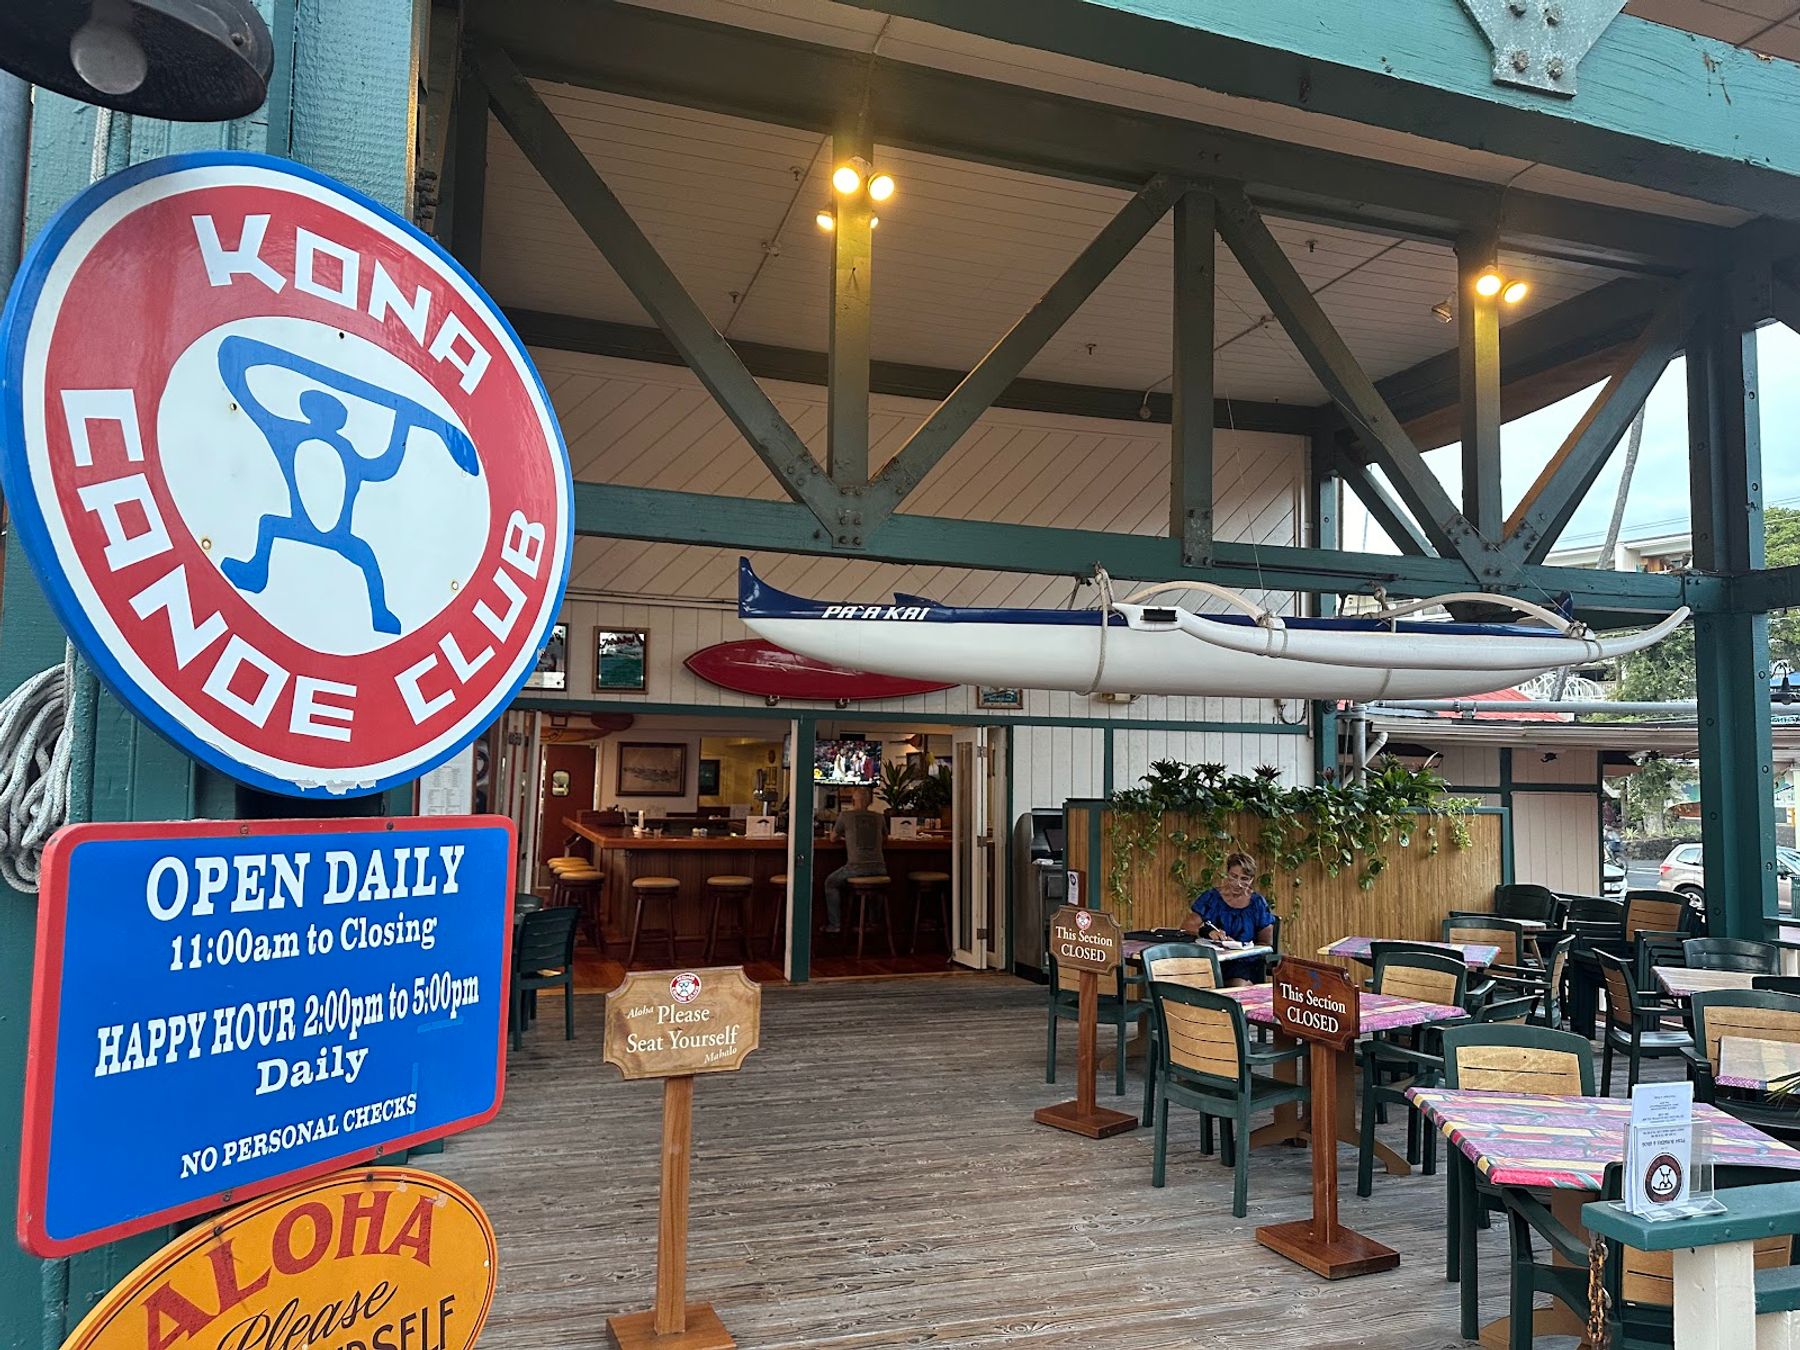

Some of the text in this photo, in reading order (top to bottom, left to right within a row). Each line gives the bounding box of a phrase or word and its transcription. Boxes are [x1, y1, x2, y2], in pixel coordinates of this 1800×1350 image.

[192, 214, 492, 395] KONA
[60, 388, 545, 742] CANOE CLUB
[883, 606, 931, 620] KAI
[146, 845, 466, 921] OPEN DAILY
[170, 912, 438, 971] 11:00am to Closing
[1055, 926, 1113, 947] This Section
[1061, 943, 1106, 963] CLOSED
[627, 1004, 710, 1024] Aloha Please
[1279, 983, 1347, 1014] This Section
[1287, 1006, 1339, 1034] CLOSED
[94, 972, 480, 1077] HAPPY HOUR 2:00pm to 5:00pm
[626, 1024, 740, 1053] Seat Yourself
[255, 1045, 369, 1096] Daily
[704, 1046, 737, 1064] Mahalo
[180, 1094, 418, 1178] NO PERSONAL CHECKS
[142, 1190, 434, 1350] ALOHA
[215, 1281, 399, 1350] Please
